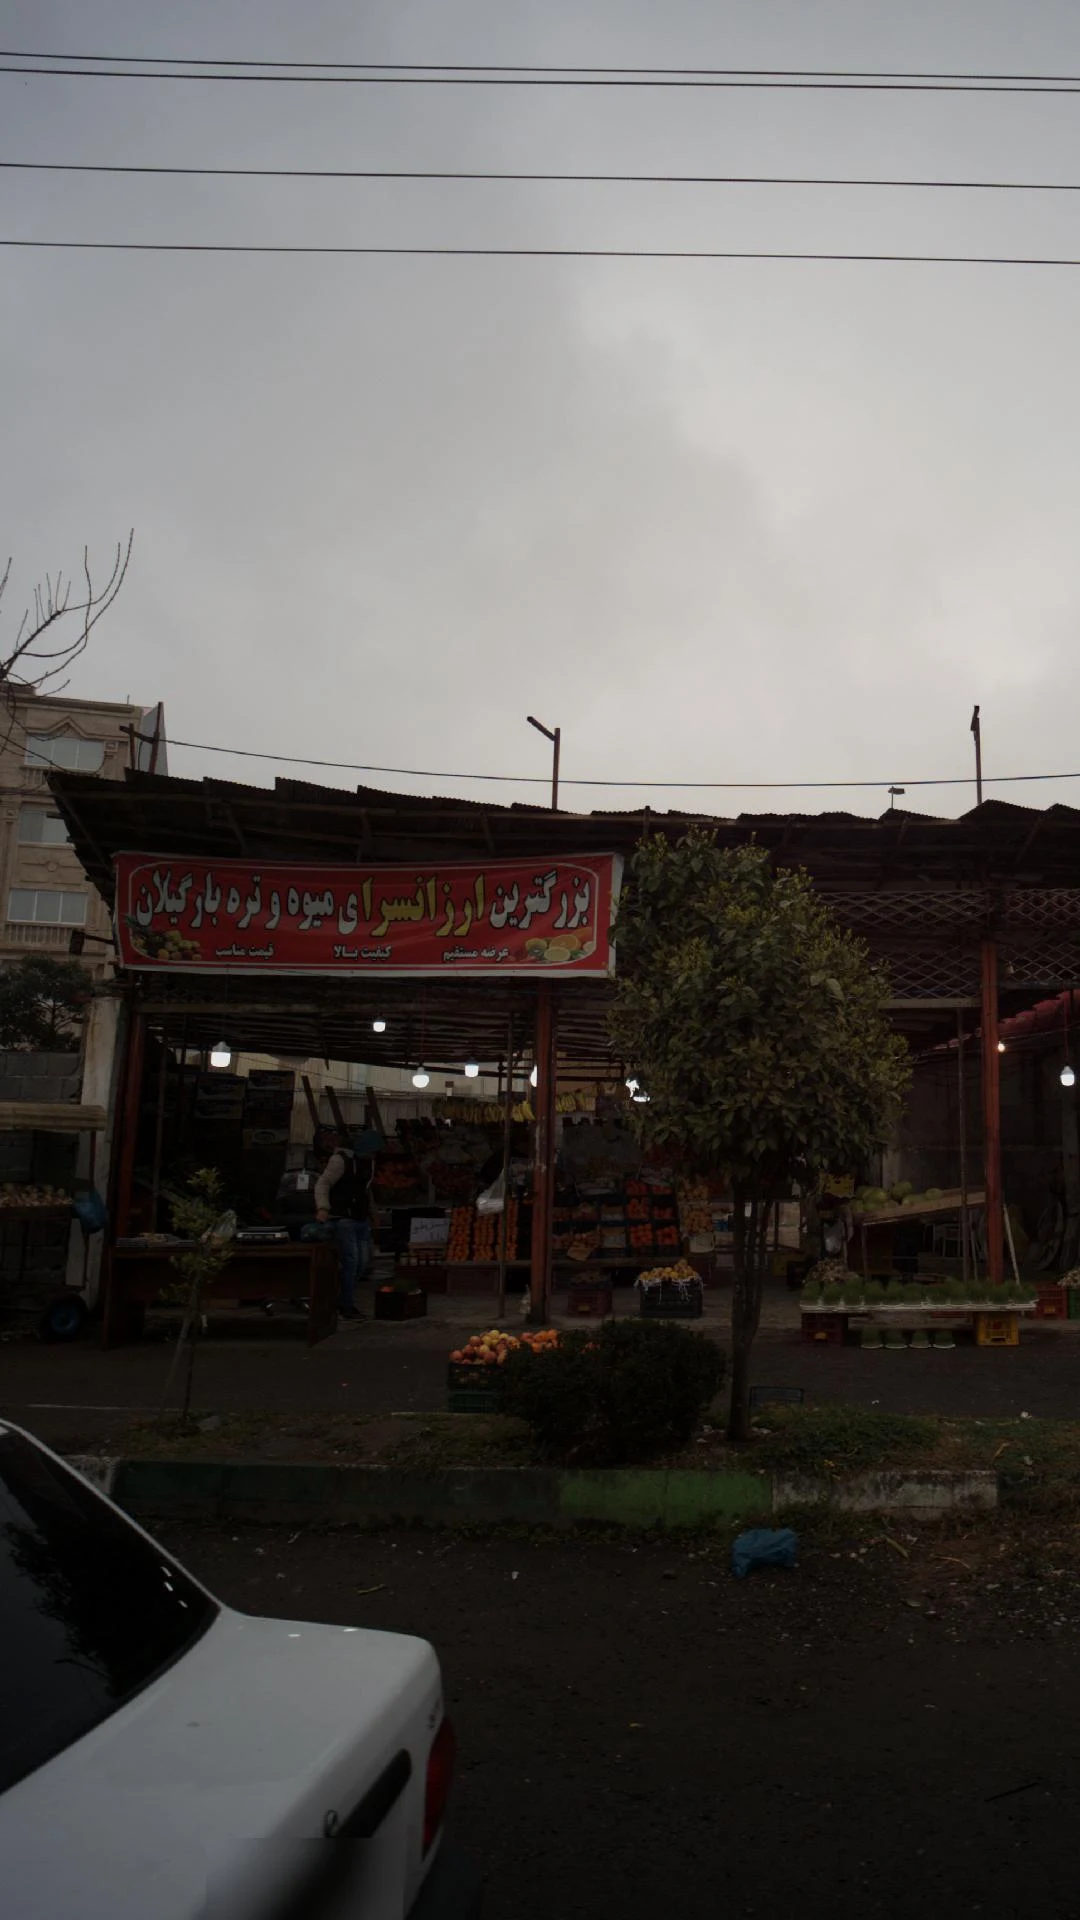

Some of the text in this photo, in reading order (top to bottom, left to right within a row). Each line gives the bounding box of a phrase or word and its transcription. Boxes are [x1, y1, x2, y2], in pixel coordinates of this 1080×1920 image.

[136, 868, 193, 926] گیلان
[264, 890, 281, 930] و
[286, 886, 335, 930] میوه
[489, 869, 591, 929] بزرگترین
[215, 943, 274, 960] قیمت مناسب
[360, 945, 392, 961] کیفیت
[443, 945, 509, 962] عرضه مستقیم
